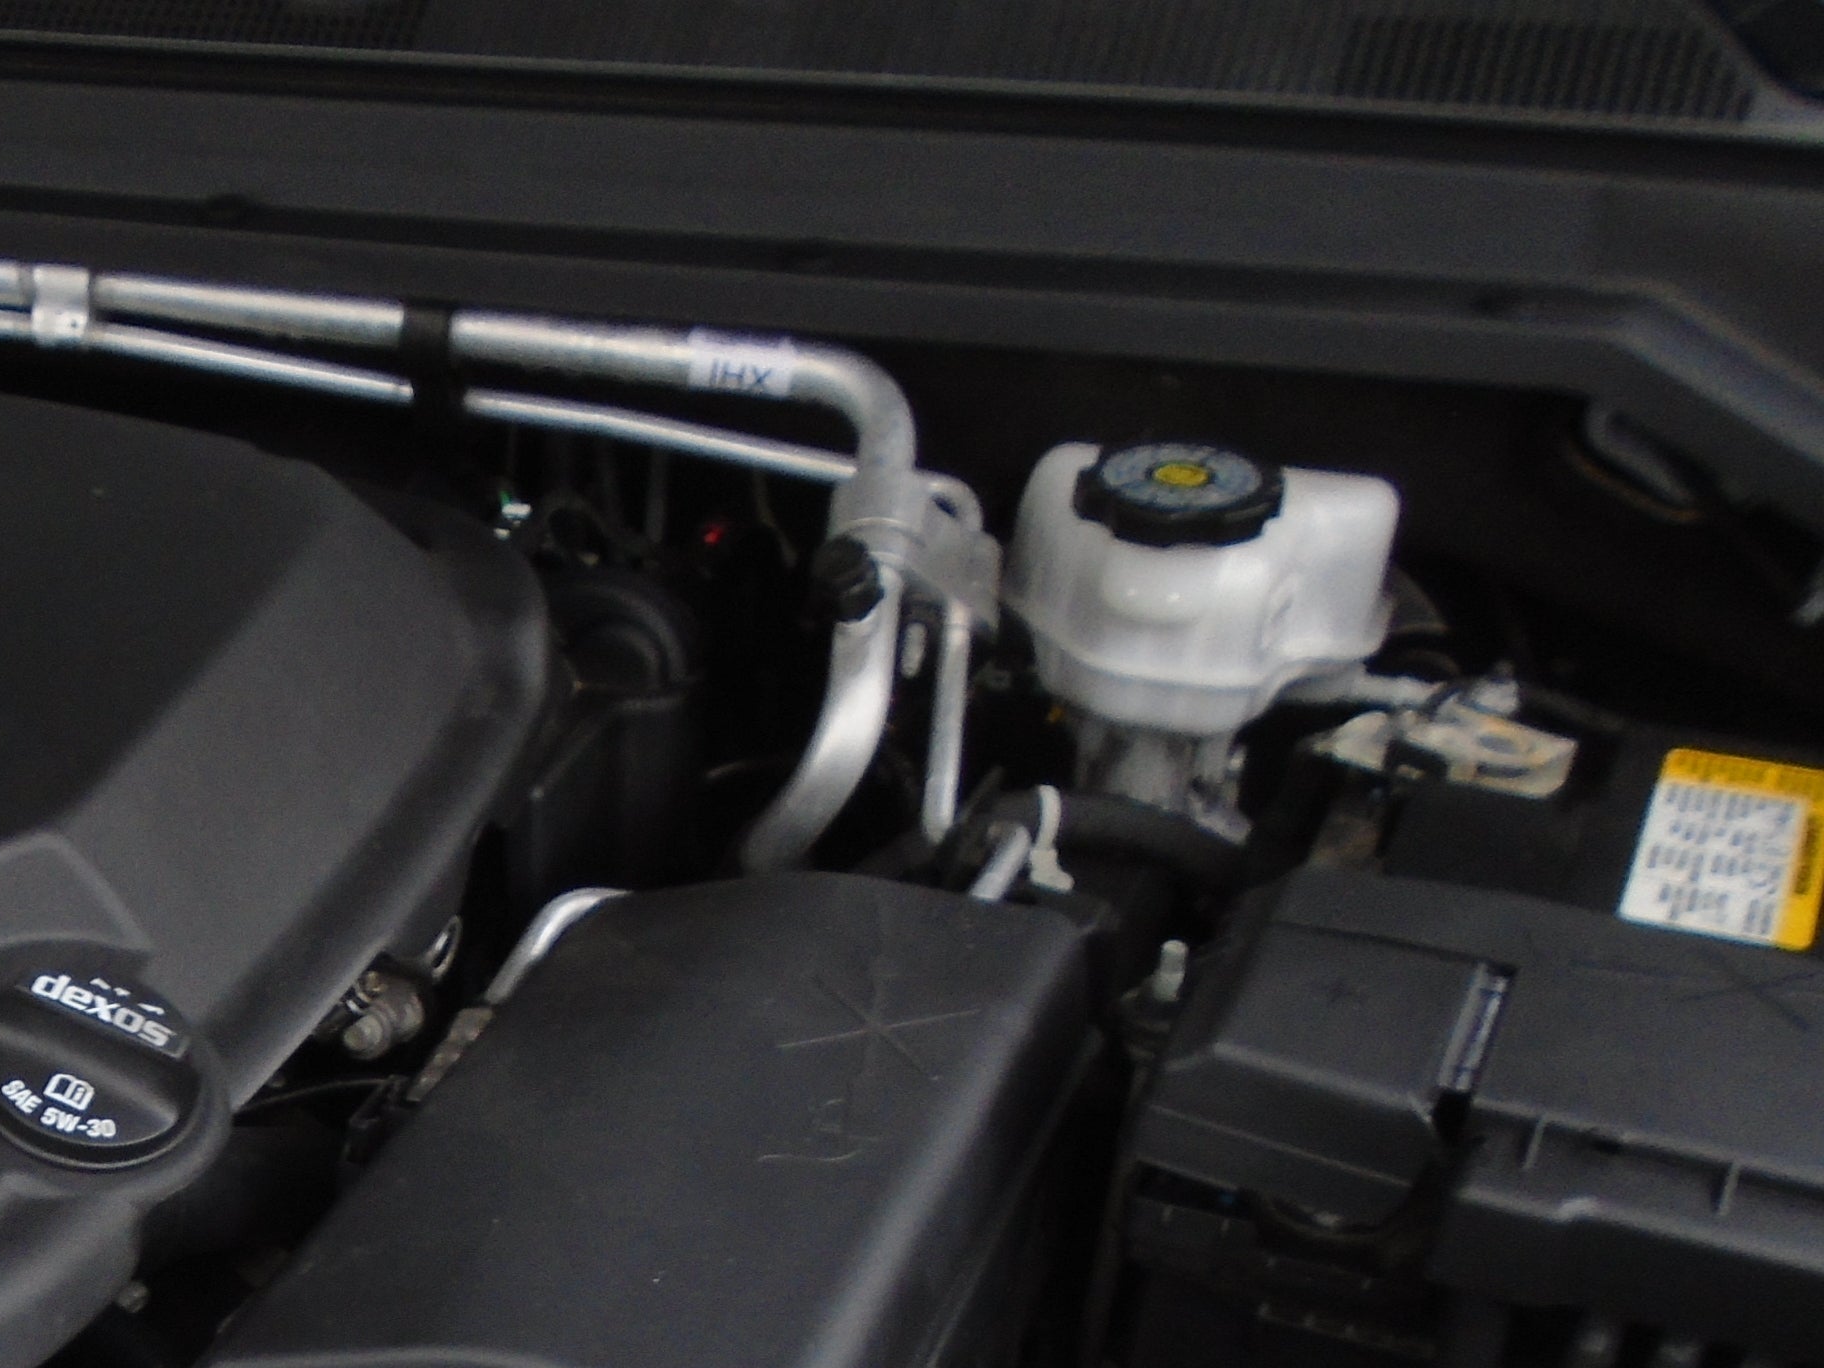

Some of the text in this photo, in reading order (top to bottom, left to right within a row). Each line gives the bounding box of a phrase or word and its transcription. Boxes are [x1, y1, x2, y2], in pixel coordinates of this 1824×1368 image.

[30, 974, 177, 1047] dexos
[0, 1079, 117, 1137] SAE 5W-30
